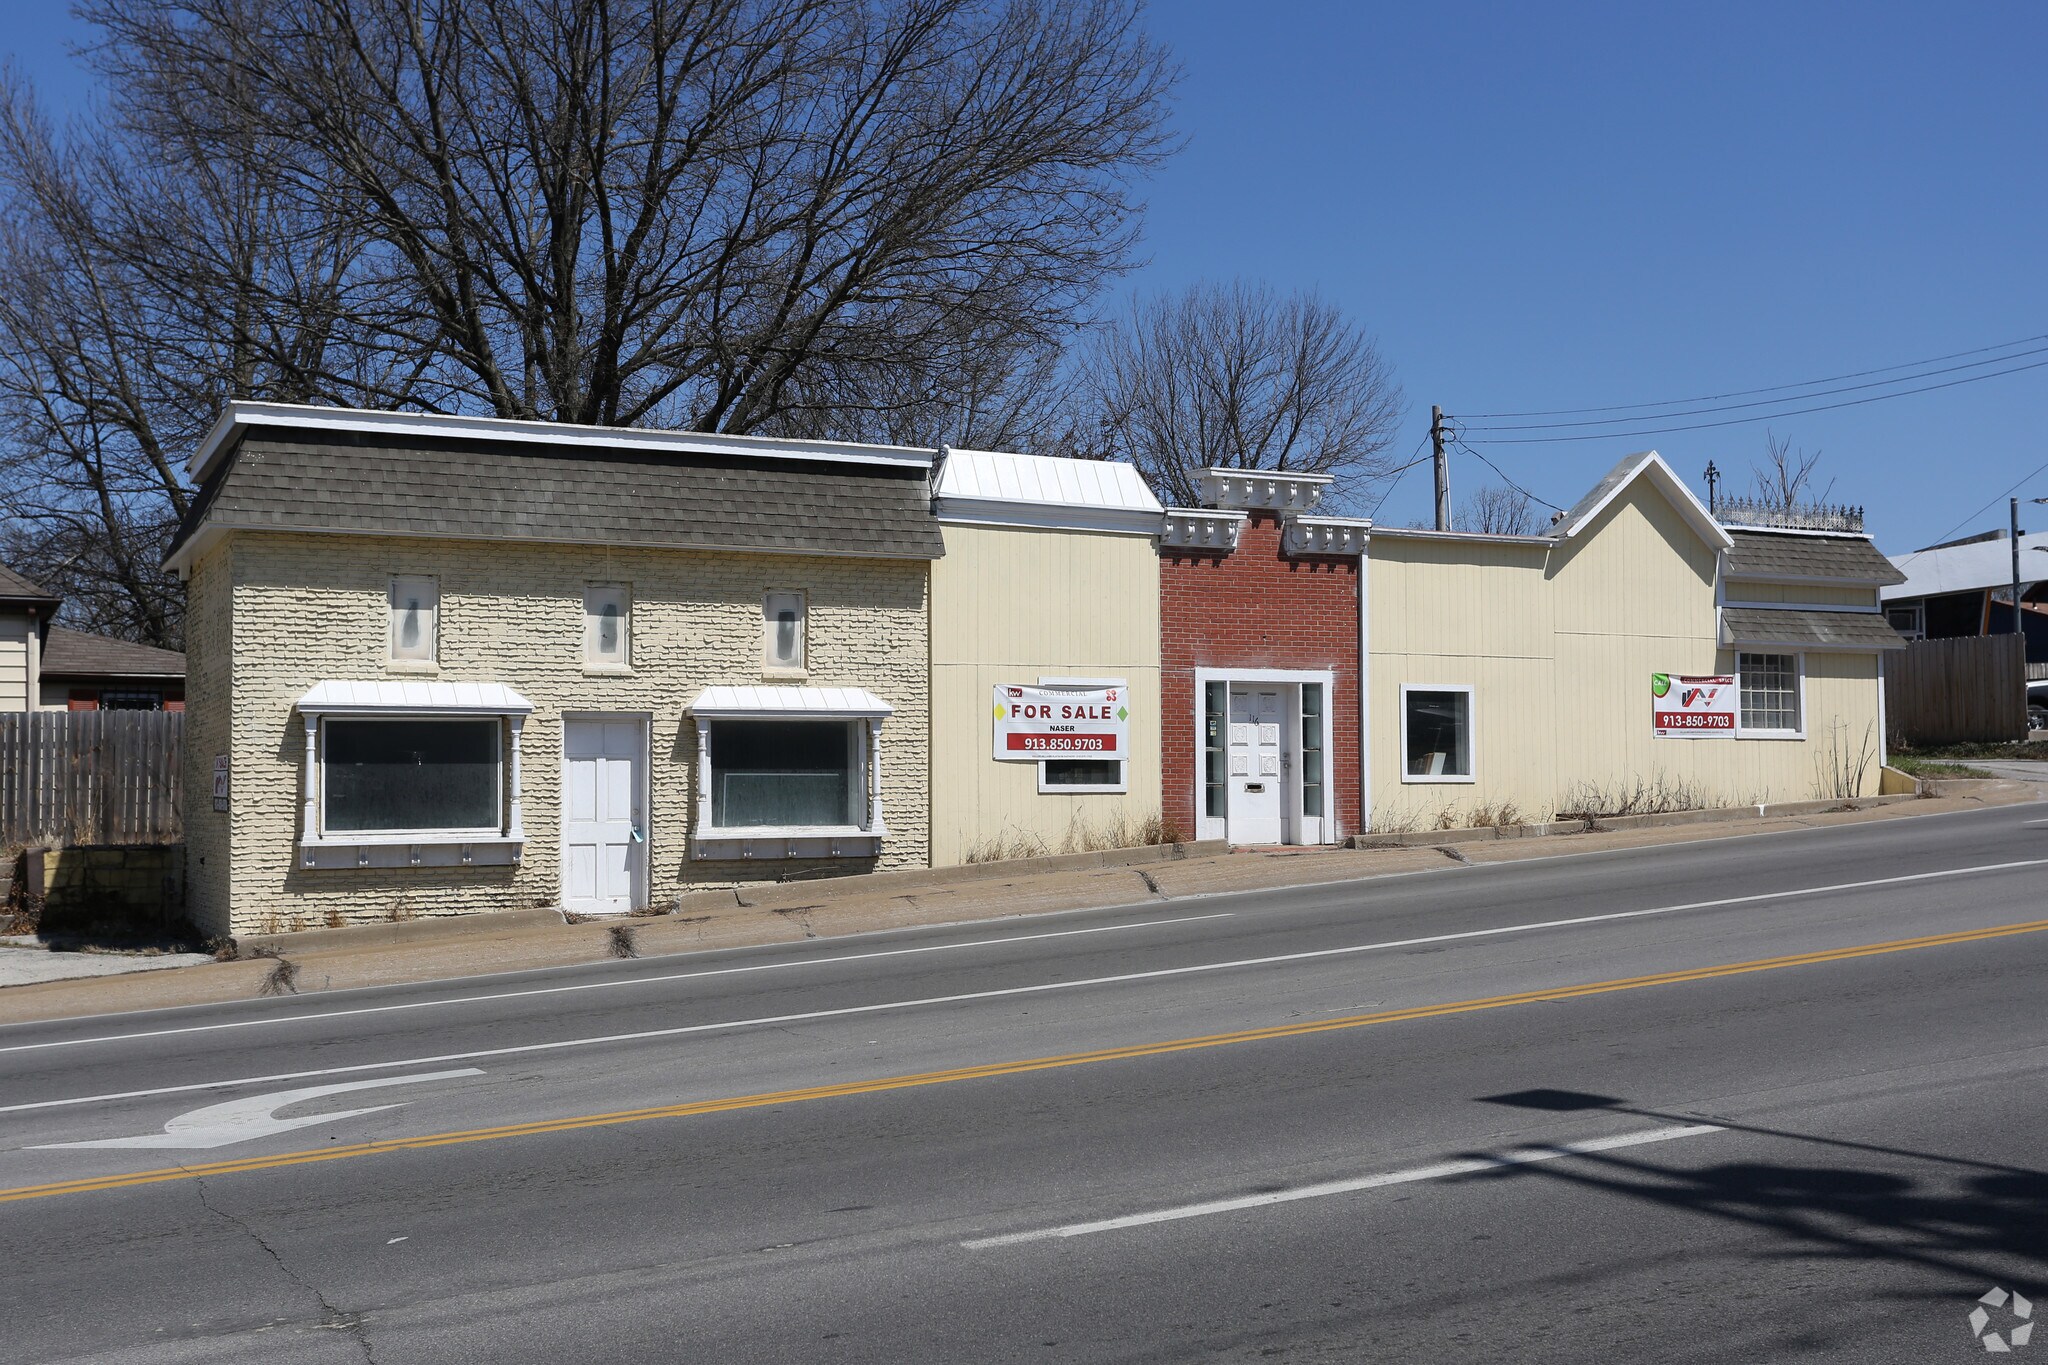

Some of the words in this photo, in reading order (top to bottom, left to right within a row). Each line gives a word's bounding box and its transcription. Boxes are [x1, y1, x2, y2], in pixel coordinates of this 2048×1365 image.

[1011, 704, 1051, 719] FOR
[1061, 705, 1111, 720] SALE
[1663, 715, 1729, 727] 913-850-9703
[1024, 738, 1103, 750] 913.850.9703
